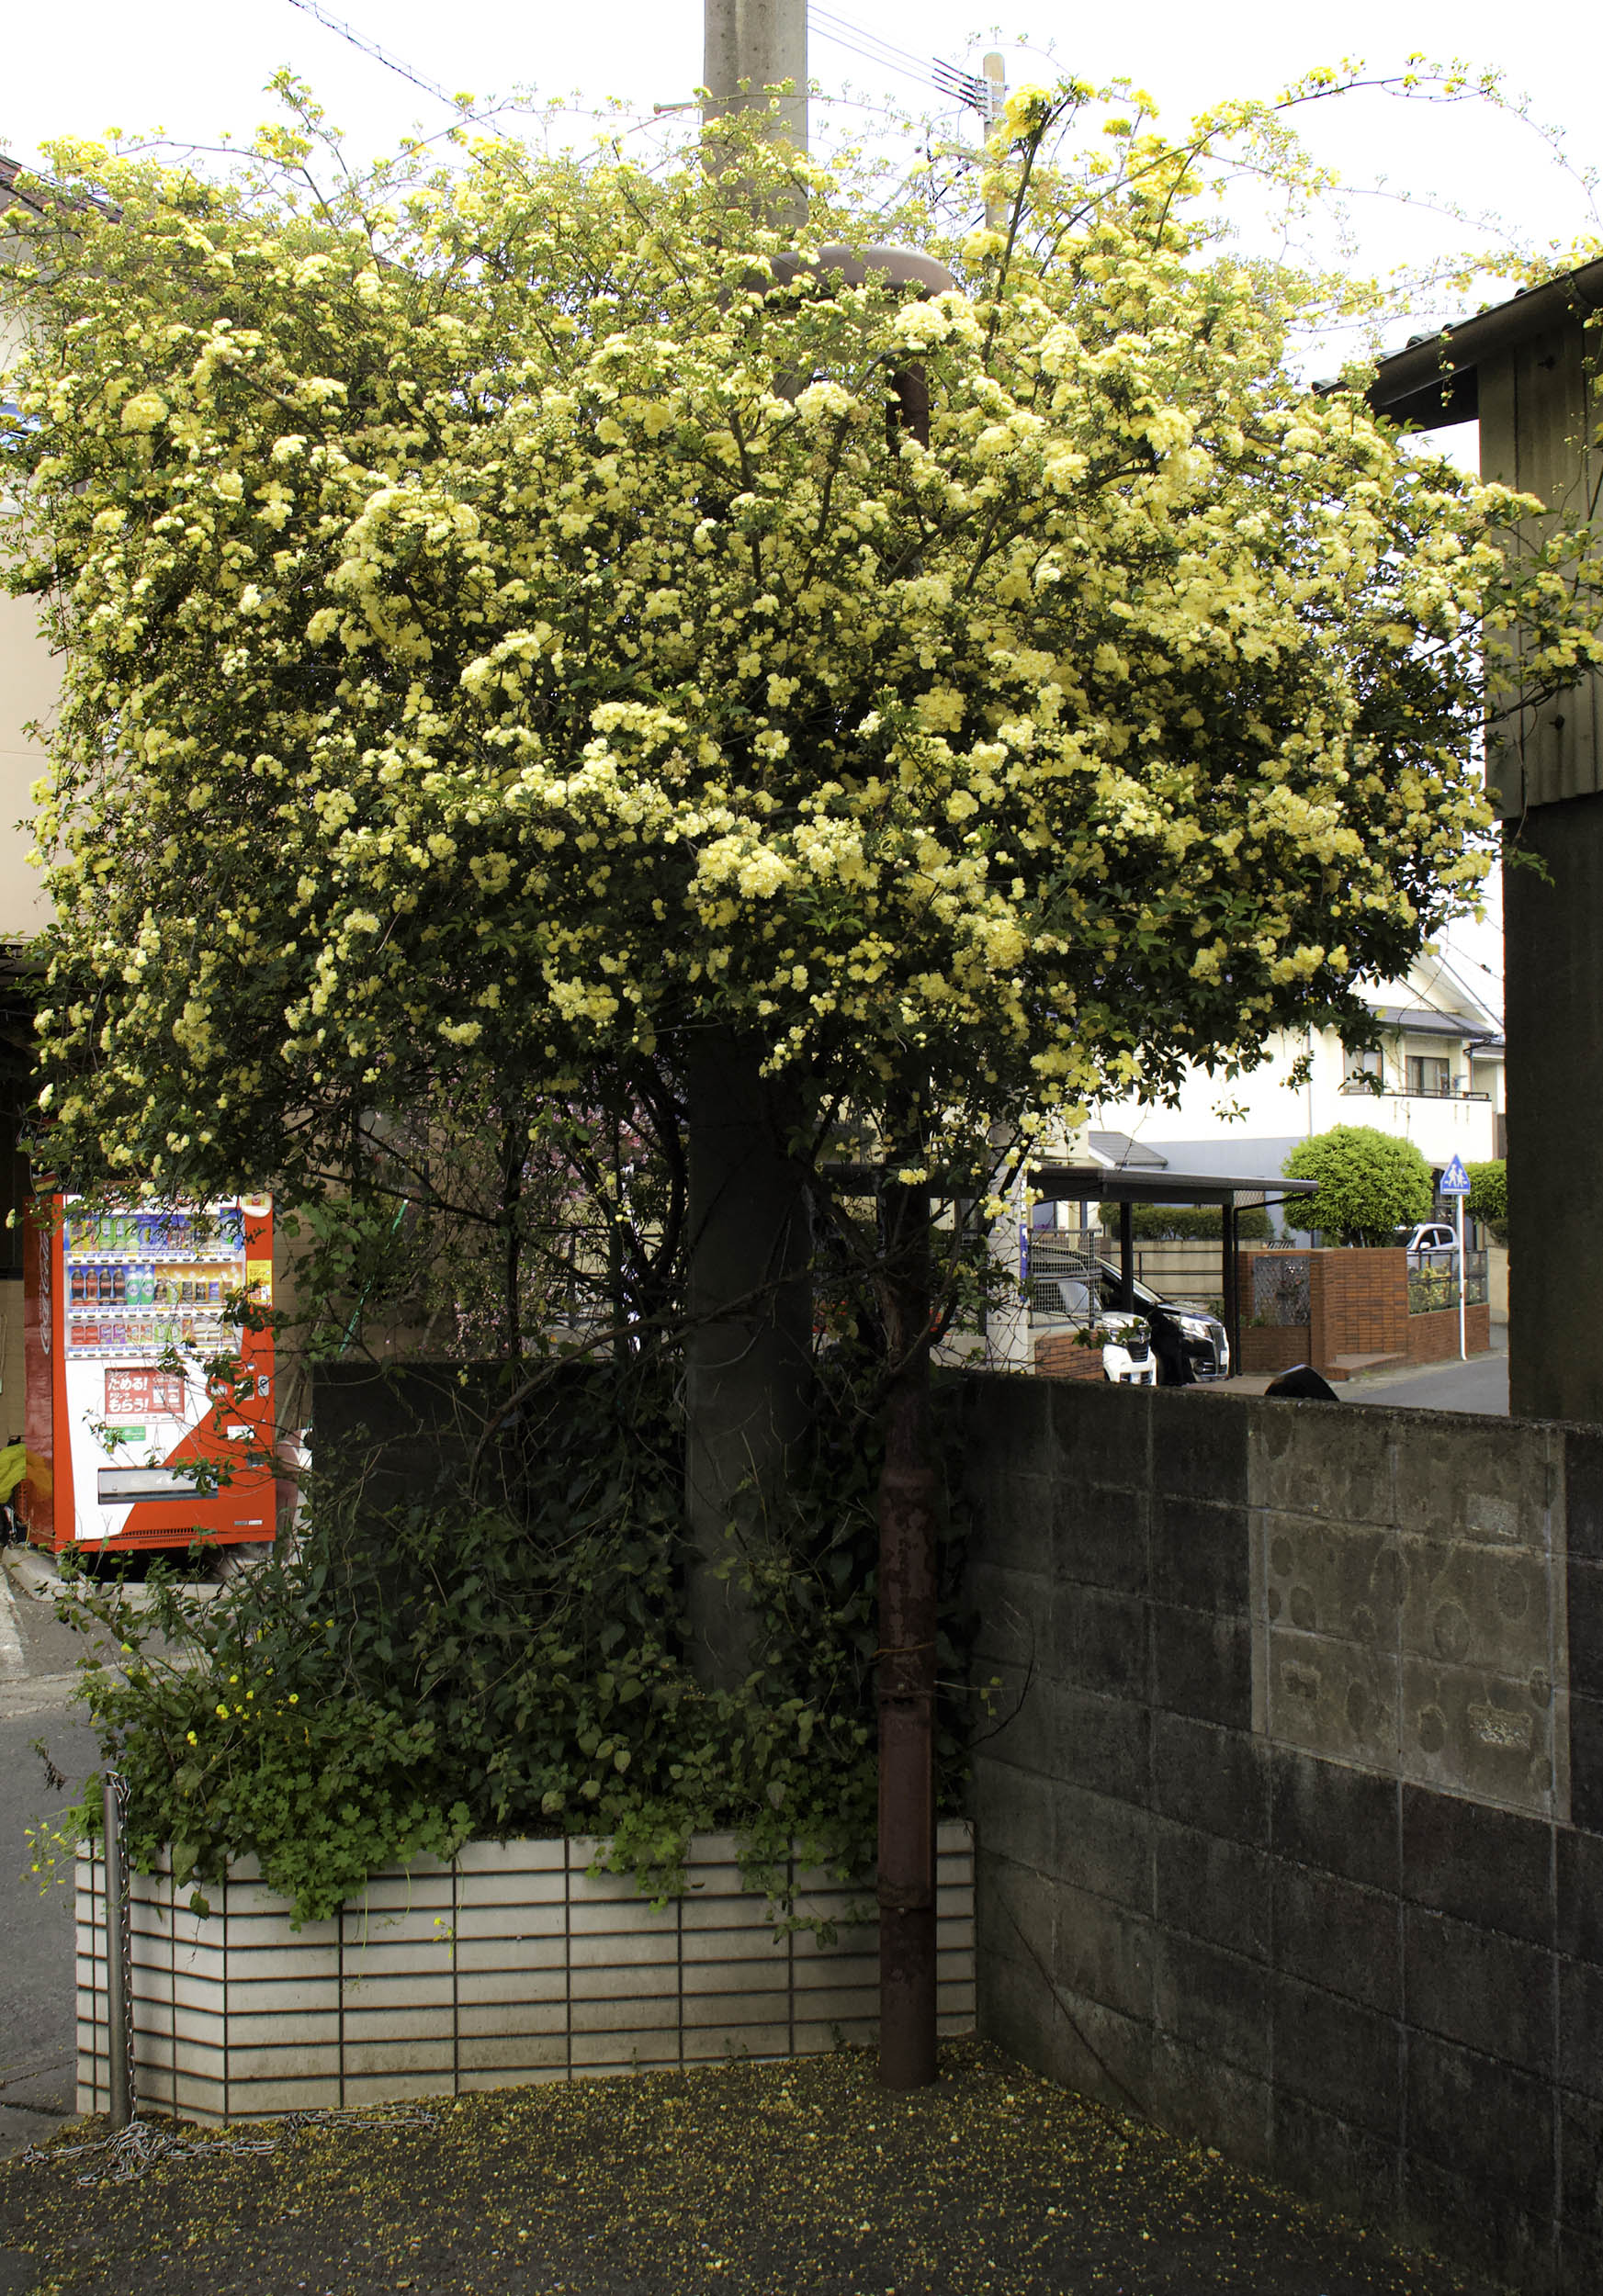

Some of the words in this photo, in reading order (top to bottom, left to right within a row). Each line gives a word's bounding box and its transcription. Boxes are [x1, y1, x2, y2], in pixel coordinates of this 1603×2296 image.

[107, 1377, 149, 1391] ためる!
[108, 1397, 150, 1412] もらう!
